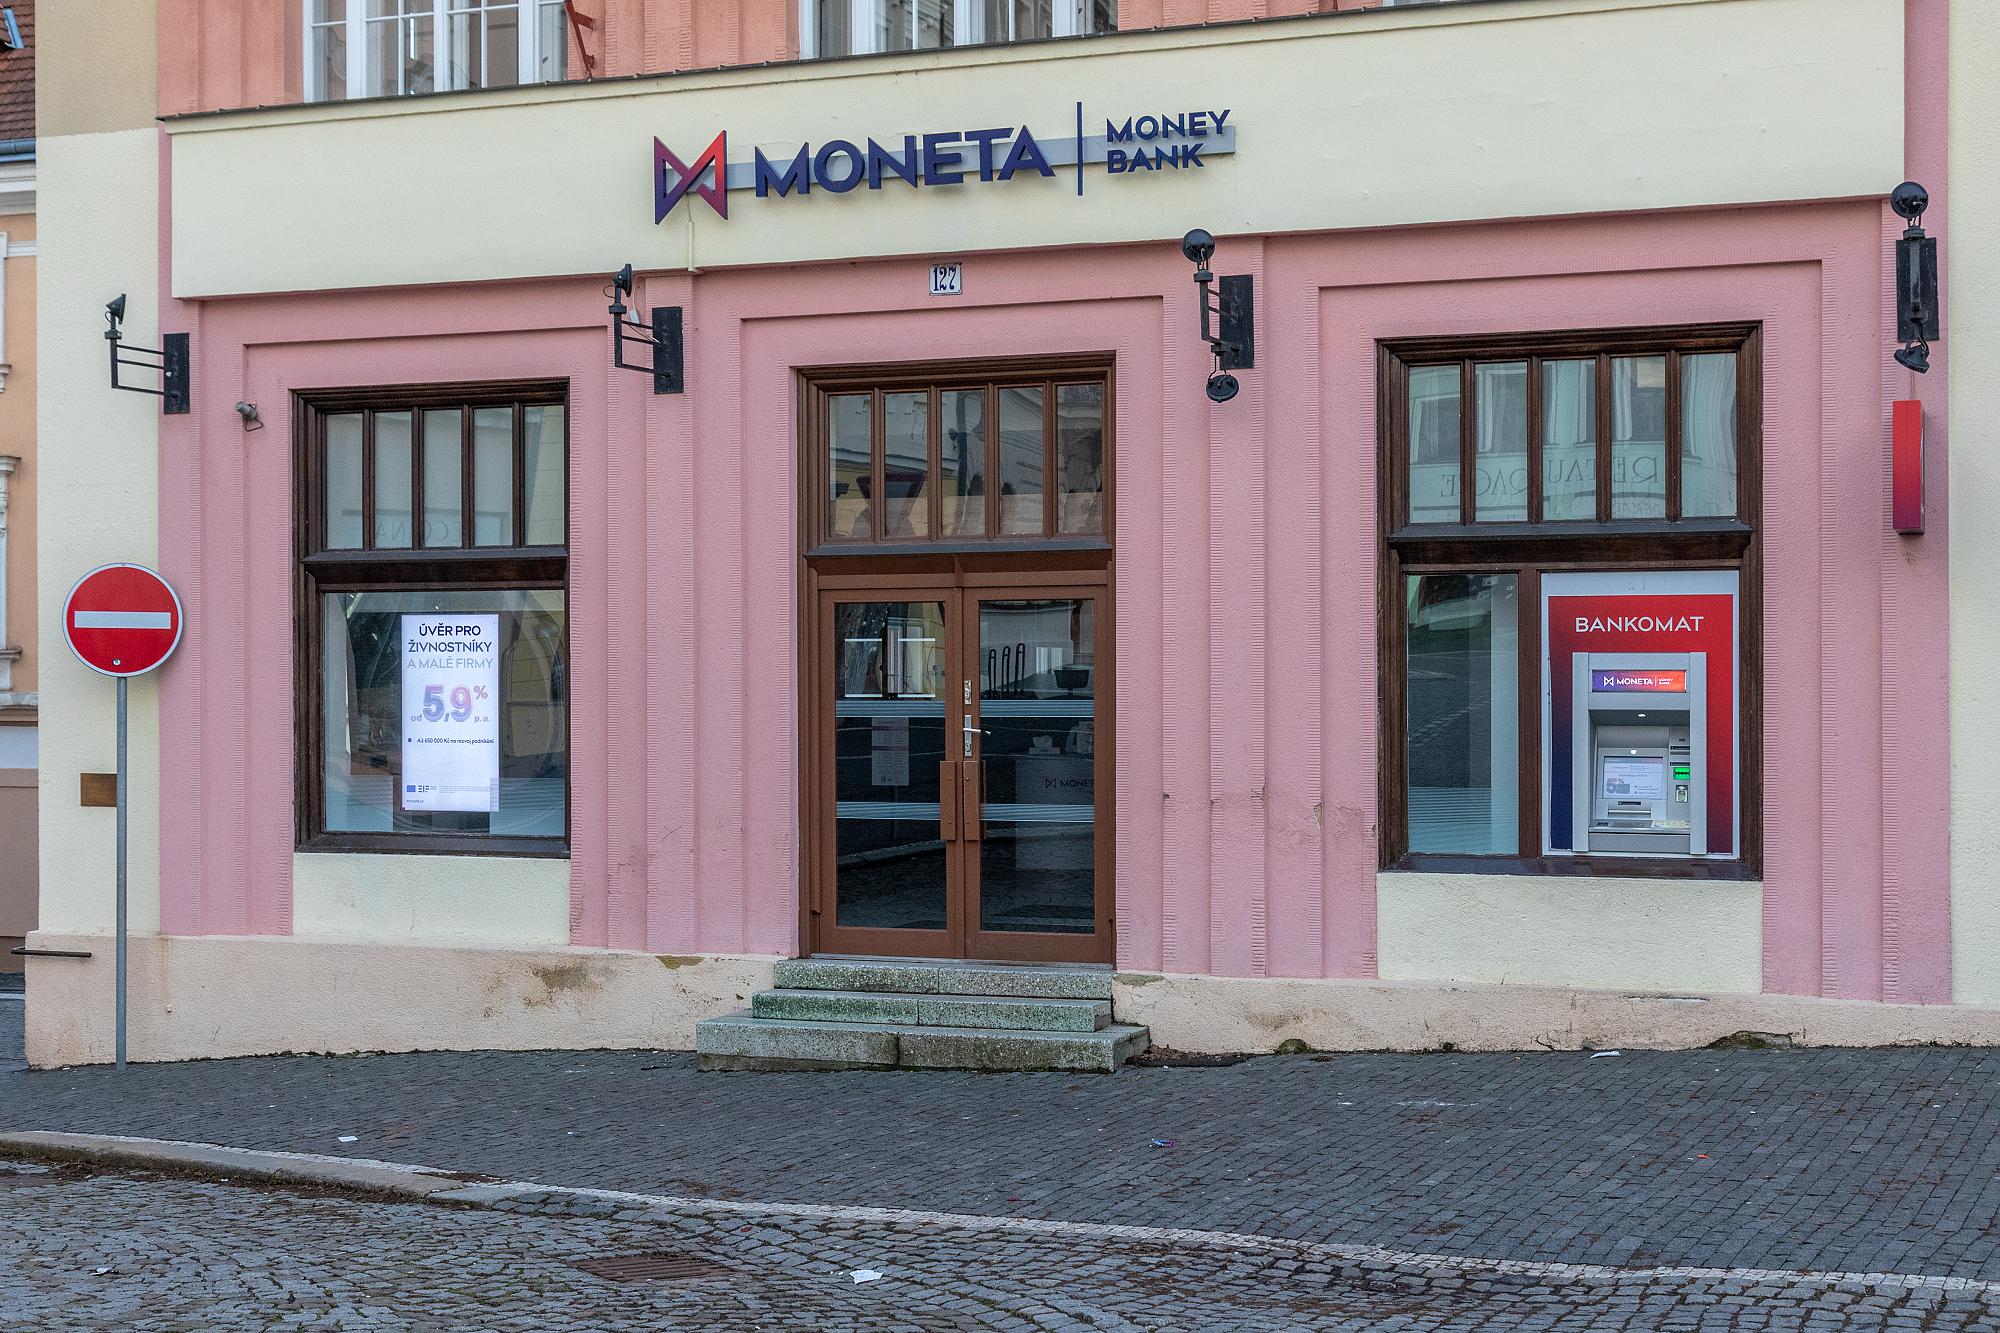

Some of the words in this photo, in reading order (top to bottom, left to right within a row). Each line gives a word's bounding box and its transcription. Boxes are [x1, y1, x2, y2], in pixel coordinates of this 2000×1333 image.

[1107, 109, 1231, 143] MONEY
[755, 124, 1056, 198] MONETA
[1107, 143, 1205, 174] BANK
[933, 266, 957, 292] 127
[419, 622, 453, 637] ÚVĚR
[455, 625, 482, 637] PRO
[1575, 616, 1705, 633] BANKOMAT
[408, 639, 493, 653] ŽIVNOSTNÍKY
[407, 658, 417, 669] A
[419, 655, 453, 669] MALÉ
[456, 658, 494, 669] FIRMY
[1616, 677, 1654, 686] MONETA
[411, 714, 422, 722] od
